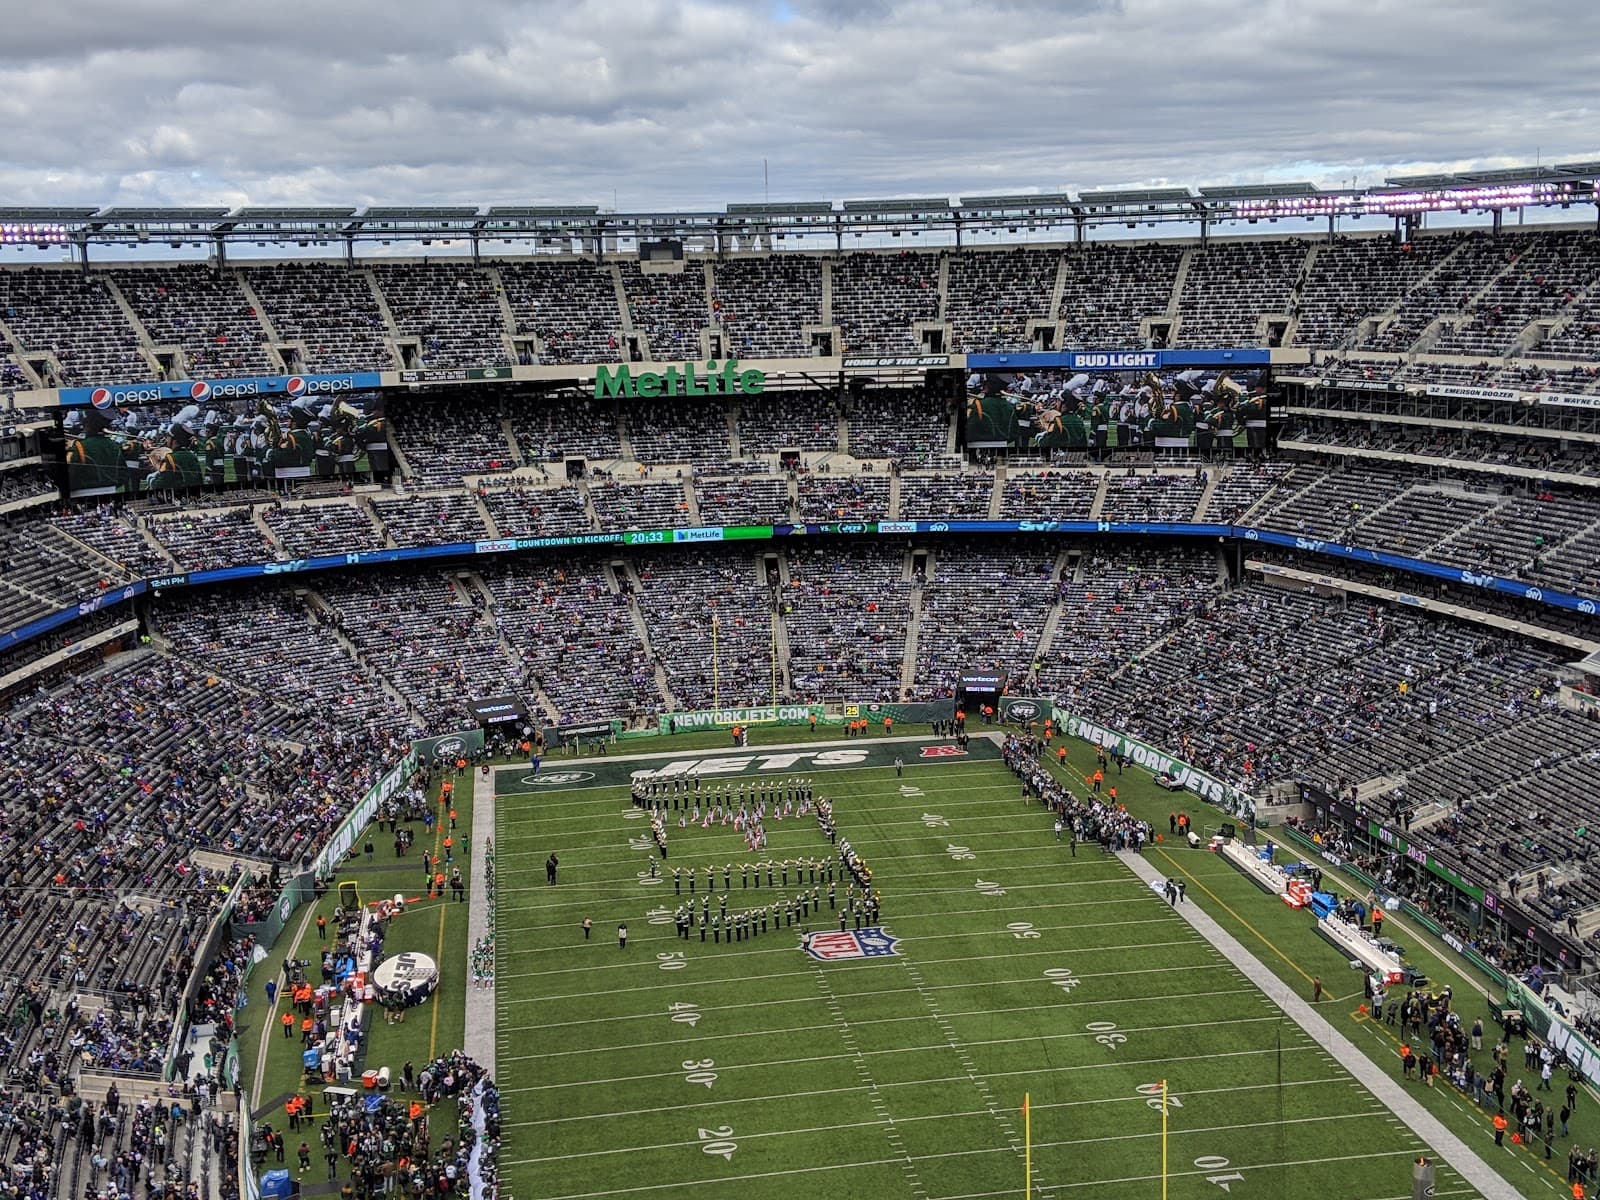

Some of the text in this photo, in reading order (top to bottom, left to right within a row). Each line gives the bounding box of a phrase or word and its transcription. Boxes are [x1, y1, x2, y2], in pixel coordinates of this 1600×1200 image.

[919, 357, 948, 365] JETS
[1075, 354, 1156, 367] BUD LIGHT
[594, 359, 766, 400] MetLife
[114, 376, 353, 406] pepsi pepsi pepsi
[1445, 388, 1481, 396] EMERSON
[1482, 390, 1514, 398] BOOZER
[1564, 397, 1592, 405] WAYNE
[517, 537, 570, 548] COUNTDOWN
[631, 532, 664, 543] 20:33
[690, 531, 720, 539] MetLife
[151, 578, 170, 587] 12:41
[476, 704, 513, 713] verizon
[846, 705, 859, 715] 25
[629, 749, 870, 778] JETS
[1077, 723, 1225, 803] NEW YORK JETS
[899, 787, 926, 798] 10
[921, 815, 950, 828] 20
[945, 847, 976, 860] 30
[975, 882, 1008, 896] 40
[646, 909, 675, 925] 40
[1006, 922, 1042, 939] 50
[812, 932, 859, 958] NFL
[1441, 932, 1464, 953] JETS
[656, 951, 688, 970] 50
[1043, 968, 1082, 987] 40
[668, 1002, 702, 1022] 40
[1086, 1021, 1128, 1044] 30
[682, 1058, 719, 1083] 30
[1135, 1083, 1184, 1110] 20
[698, 1125, 738, 1155] 20
[1193, 1155, 1246, 1185] 10
